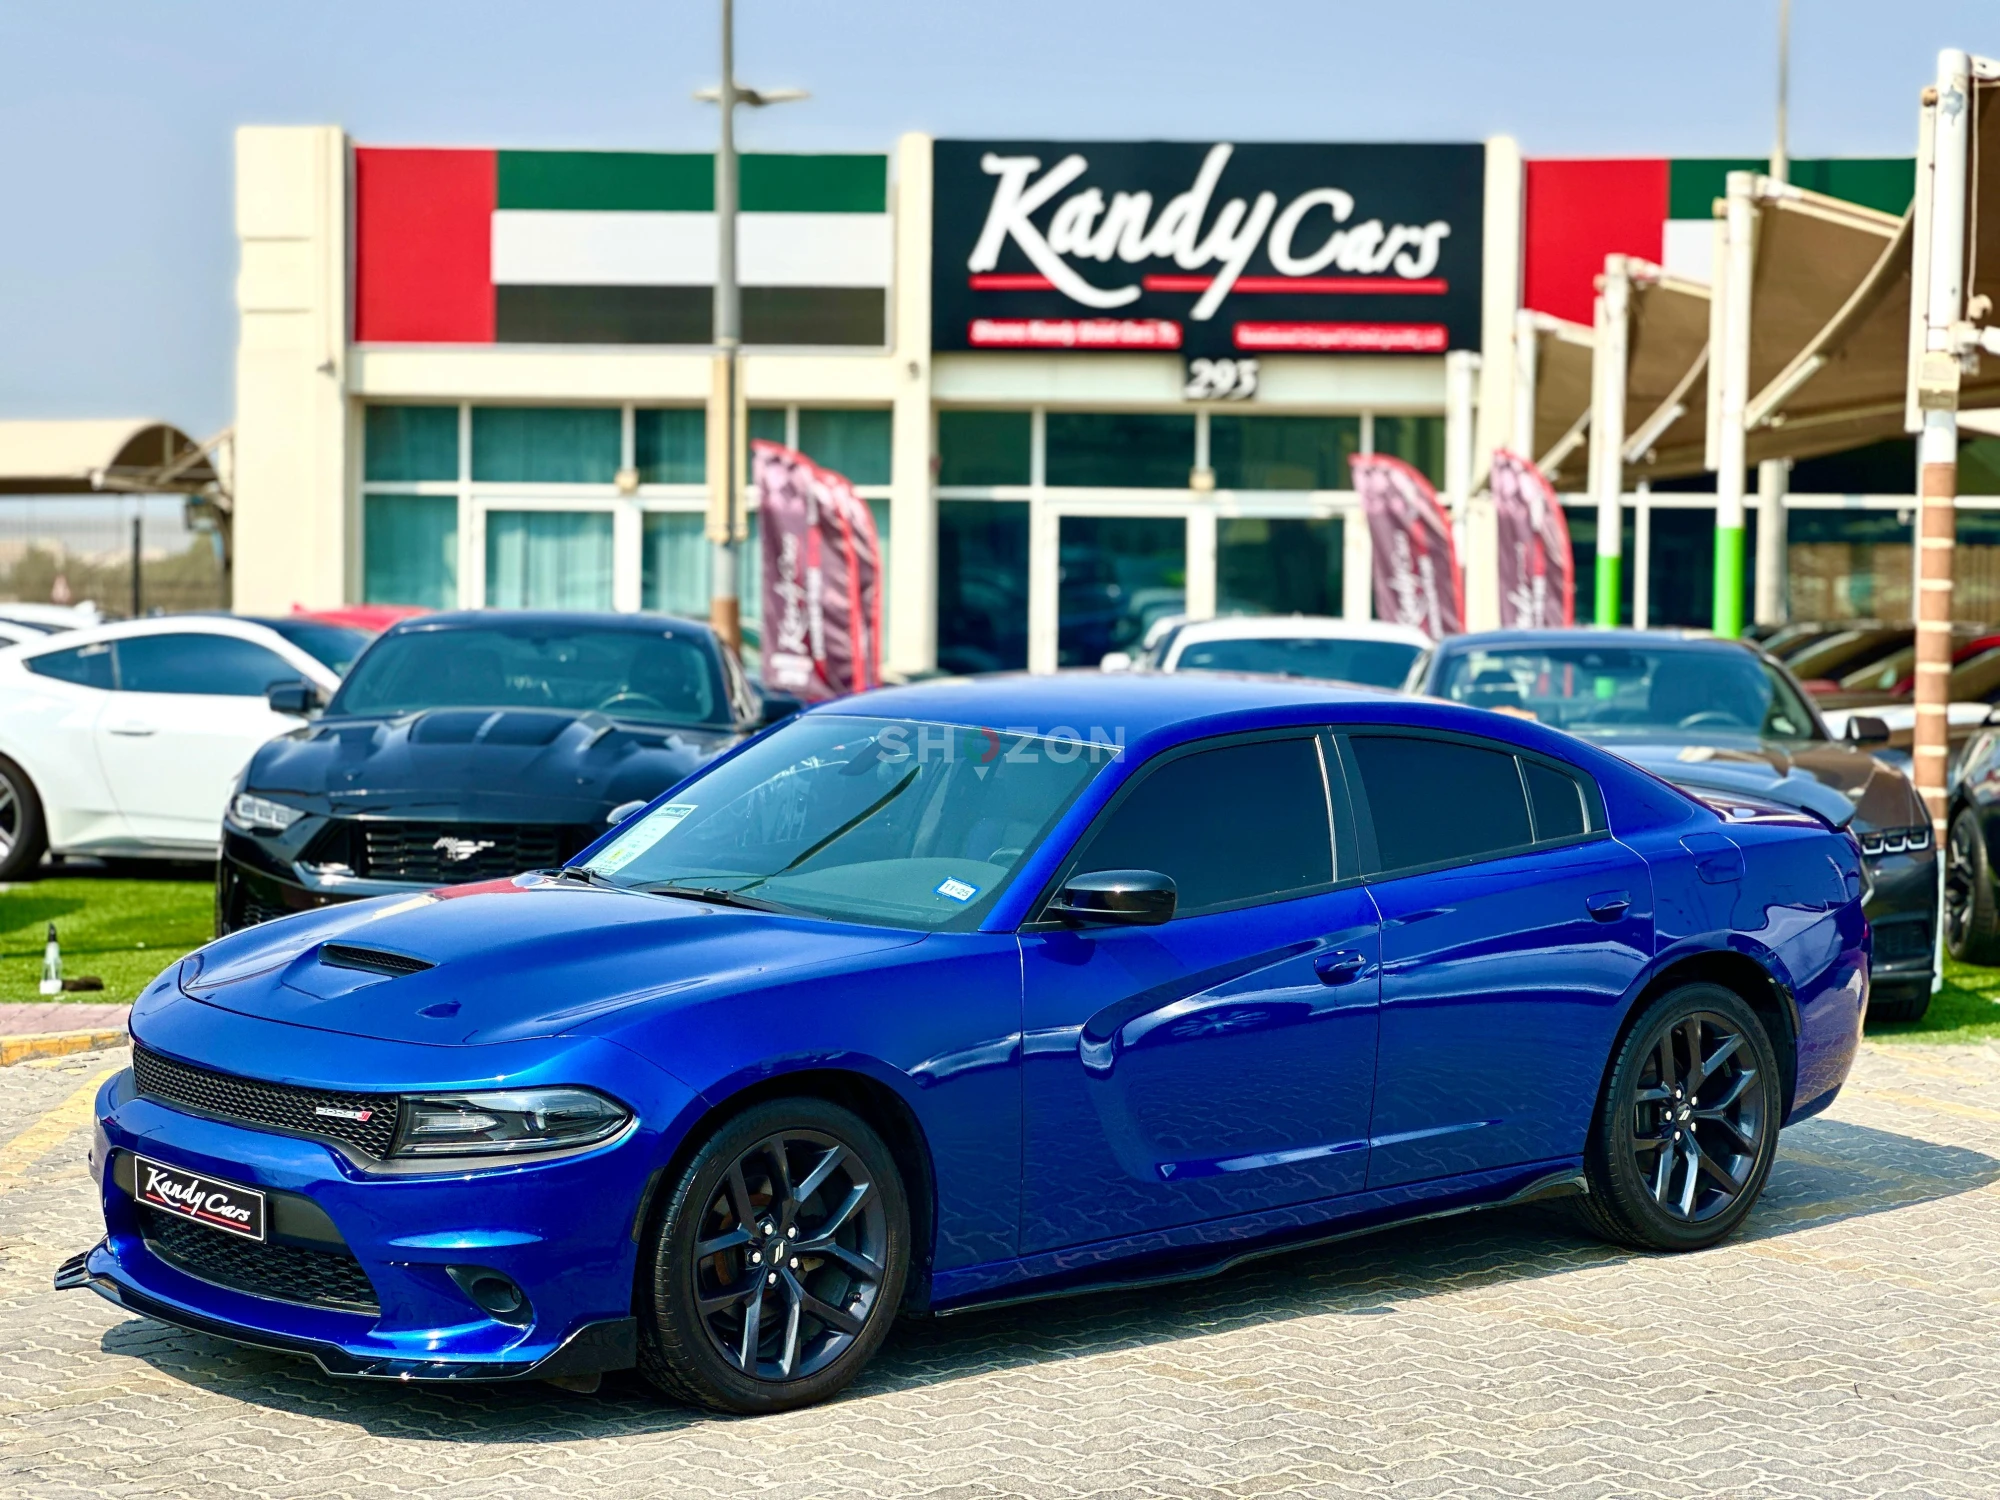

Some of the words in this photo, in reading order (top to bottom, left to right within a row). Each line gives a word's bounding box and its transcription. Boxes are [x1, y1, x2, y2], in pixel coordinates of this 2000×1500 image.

[967, 142, 1277, 321] Kandy
[1267, 187, 1451, 280] Cars
[1184, 356, 1260, 399] 295
[145, 1166, 206, 1216] Kandy
[205, 1193, 251, 1222] Cars
